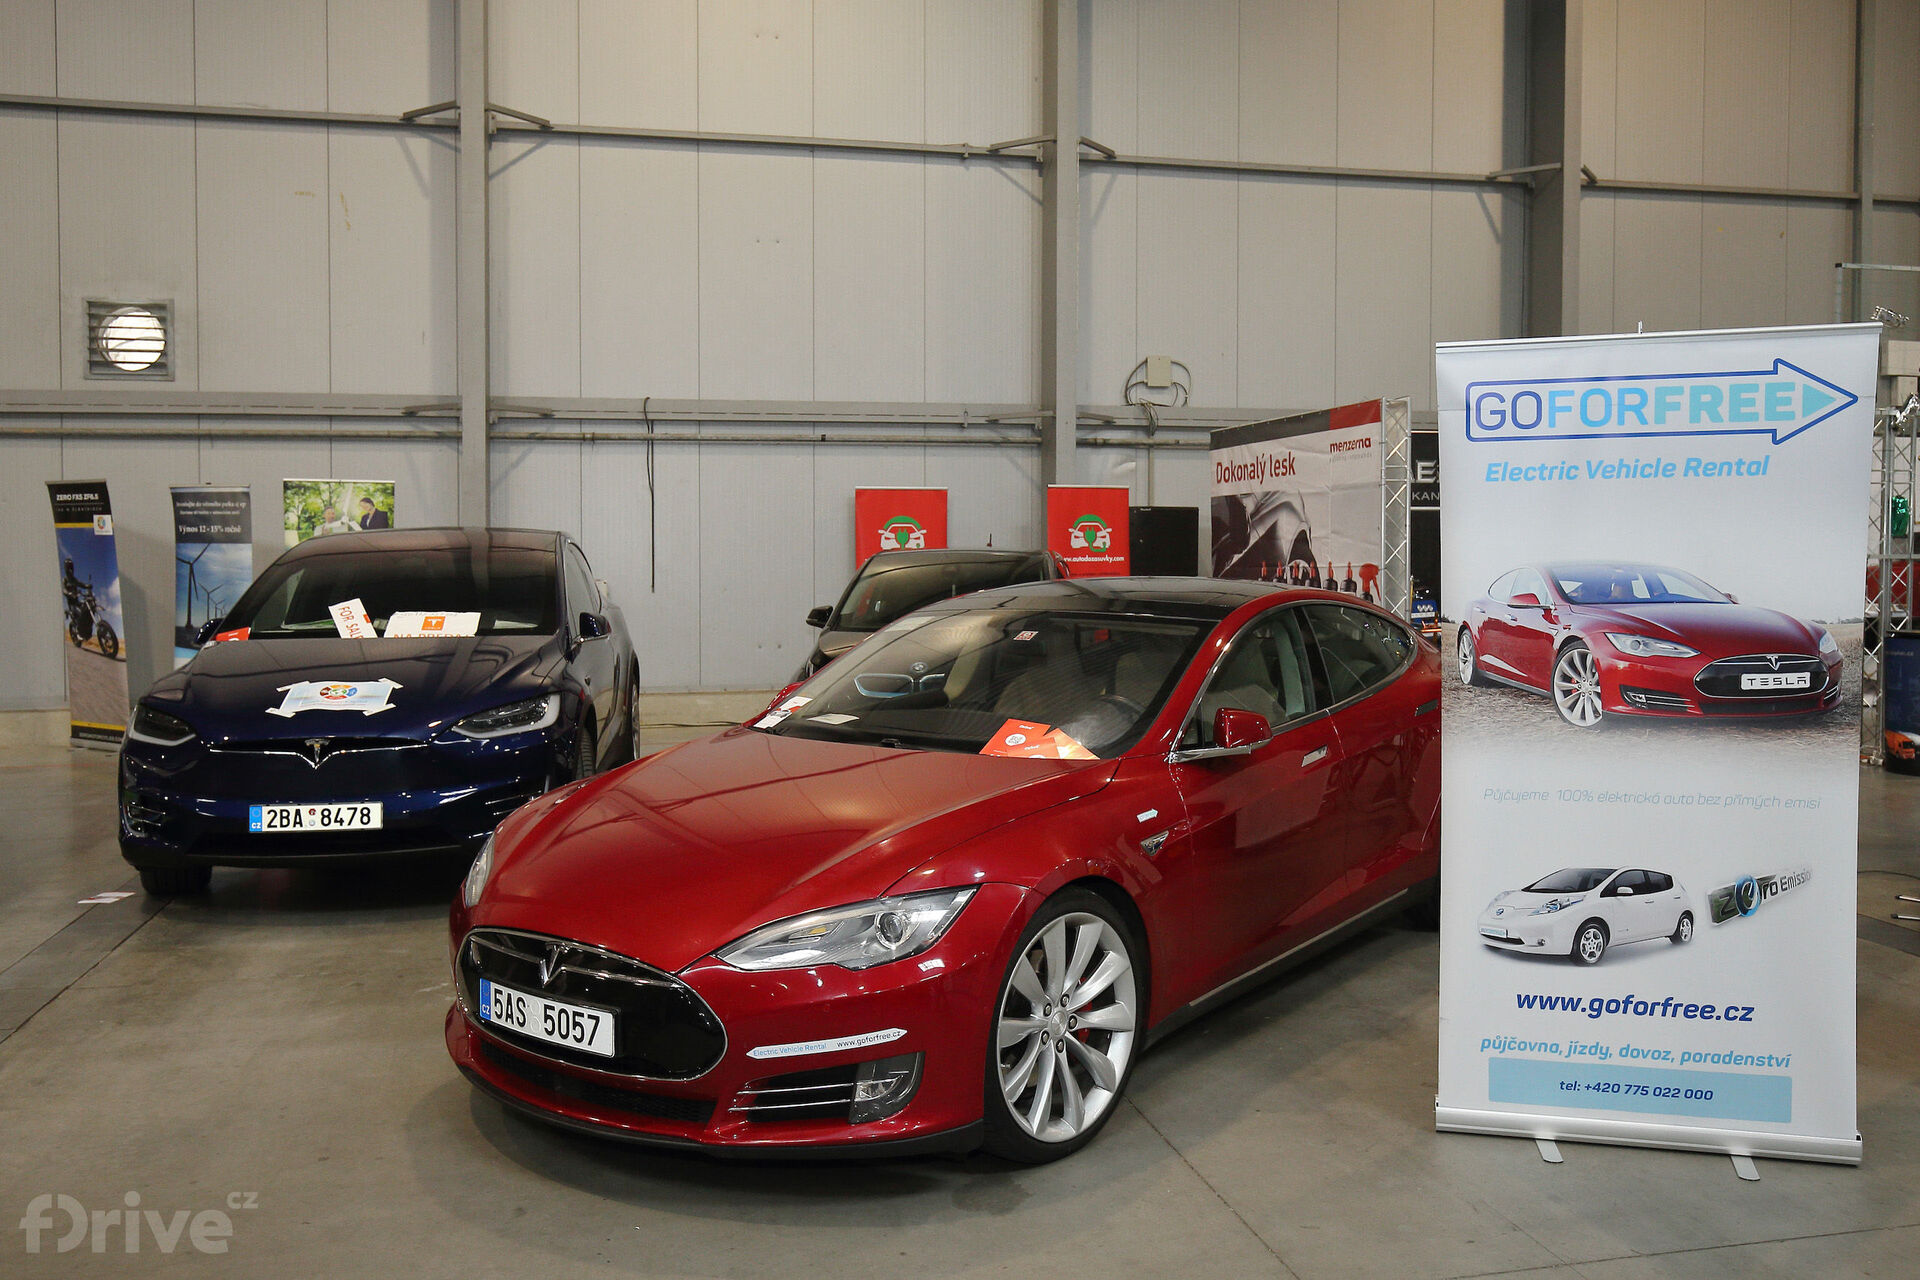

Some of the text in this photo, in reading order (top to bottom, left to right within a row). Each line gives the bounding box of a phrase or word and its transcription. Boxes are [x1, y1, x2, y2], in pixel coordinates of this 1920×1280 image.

[1474, 381, 1796, 431] GOFORFREE
[1329, 437, 1372, 454] menzerna
[1216, 451, 1296, 485] Dokonalý lesk
[1485, 454, 1771, 483] Electric Vehicle Rental
[178, 524, 198, 535] Výnos
[199, 525, 206, 533] 12
[338, 606, 355, 622] FOR
[1746, 676, 1807, 686] TESLA
[1483, 788, 1550, 803] Půjčujeme
[1557, 789, 1594, 802] 100%
[1663, 793, 1694, 806] auto
[1697, 792, 1721, 806] bez
[266, 808, 304, 829] 2BA
[320, 806, 372, 827] 8478
[481, 987, 601, 1047] CZ 5AS 5057
[1516, 993, 1755, 1022] www.goforfree.cz
[753, 1030, 901, 1057] Electric Vehicle Rental www.goforfree.cz
[1480, 1035, 1793, 1068] půjčovna, jízdy, dovoz, poradenství
[1559, 1080, 1714, 1101] tel: +420 775 022 000
